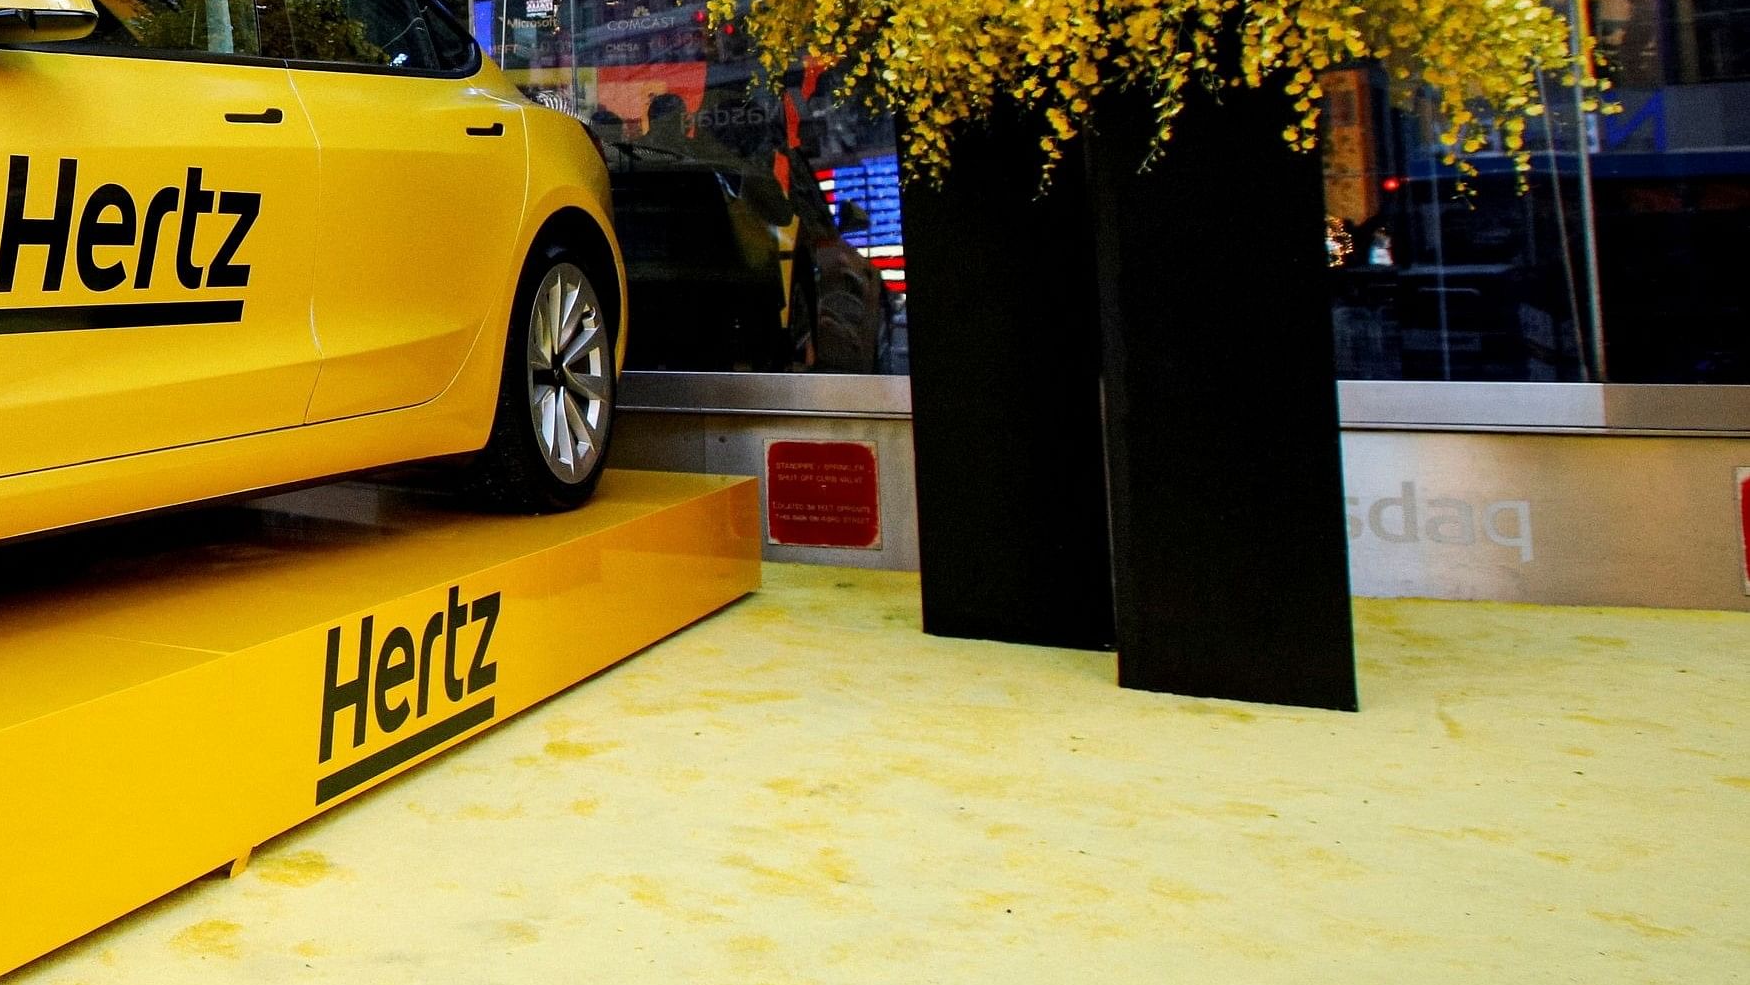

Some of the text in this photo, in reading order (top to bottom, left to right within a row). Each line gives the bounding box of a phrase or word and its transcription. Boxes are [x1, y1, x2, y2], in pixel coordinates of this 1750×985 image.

[506, 16, 556, 30] Microsoft
[606, 16, 675, 31] COMCAST
[318, 585, 501, 764] Hertz
